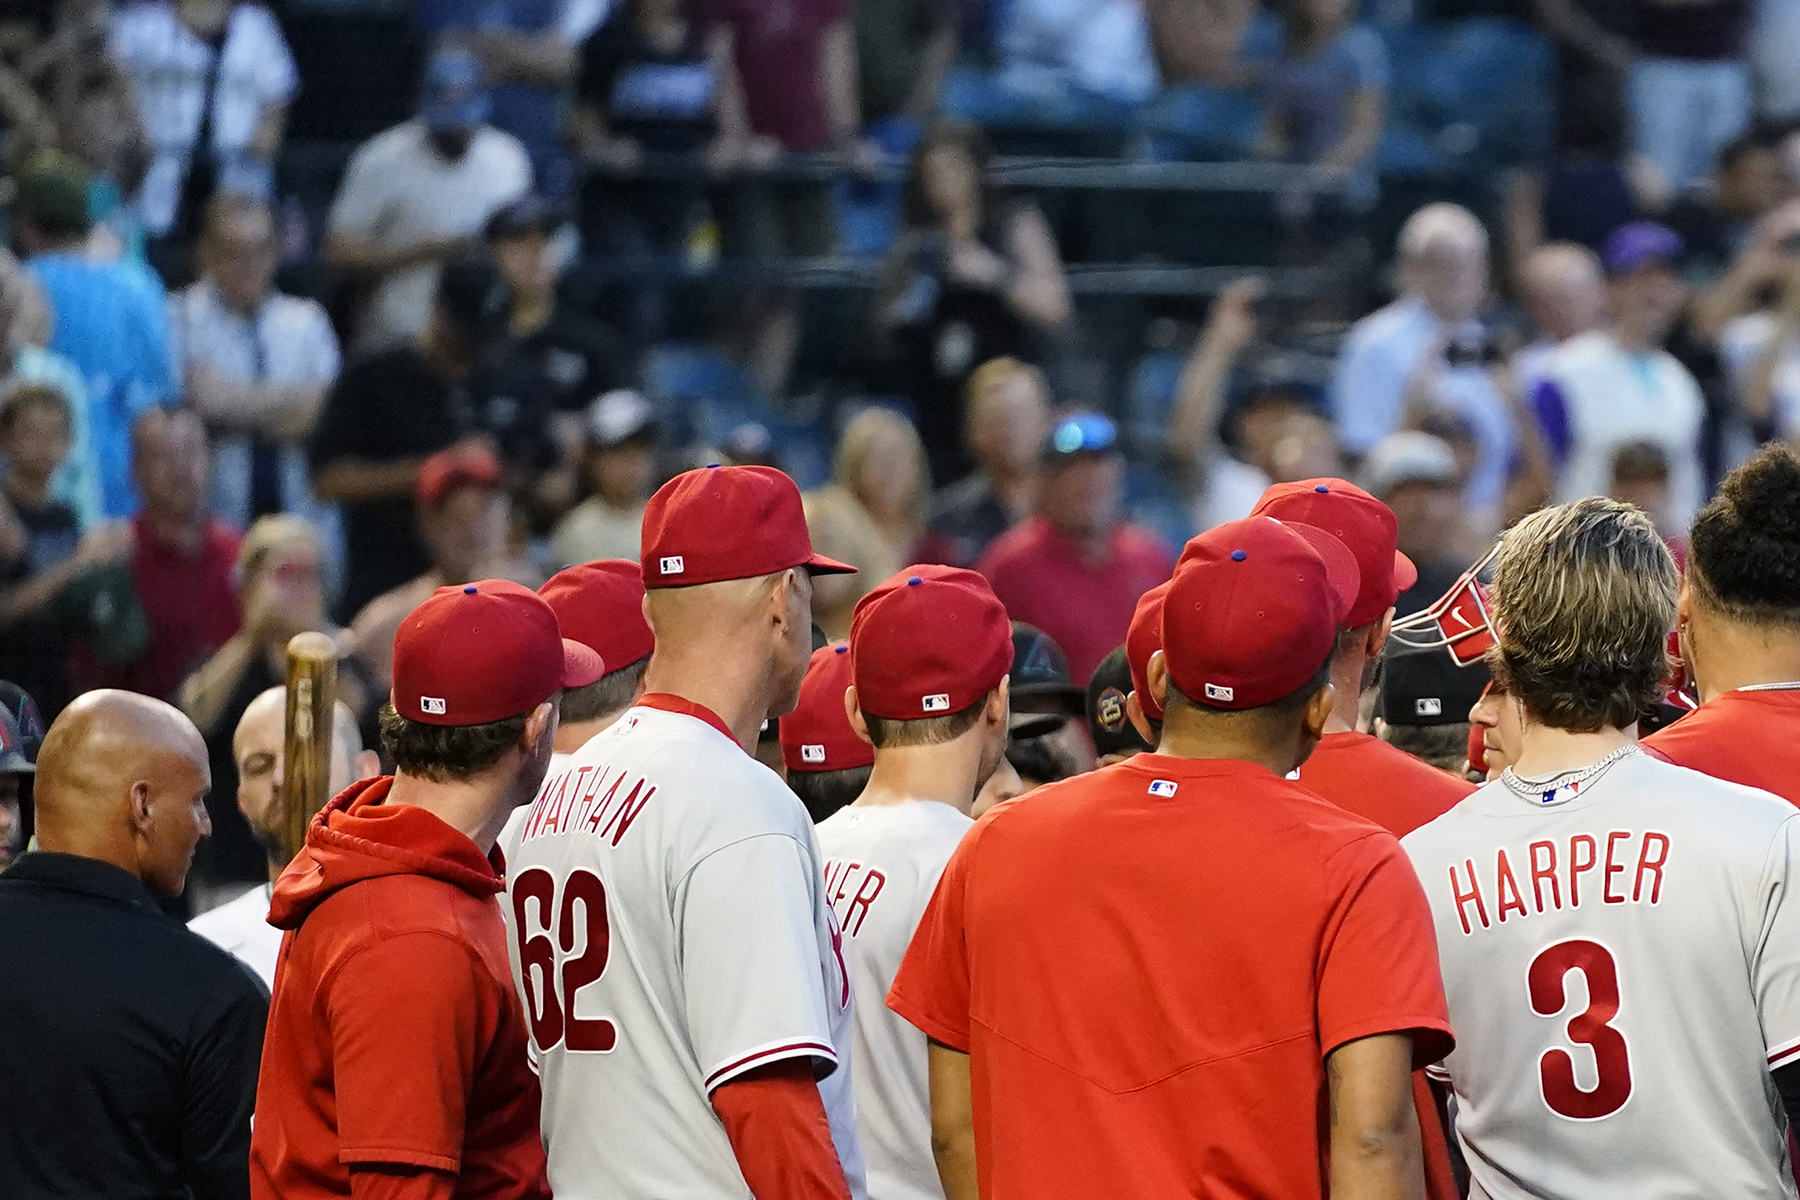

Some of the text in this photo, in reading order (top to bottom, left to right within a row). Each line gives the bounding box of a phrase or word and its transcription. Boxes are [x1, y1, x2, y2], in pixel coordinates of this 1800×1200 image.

[520, 764, 658, 849] WATHAN
[1448, 829, 1671, 937] HARPER
[511, 866, 618, 1055] 62
[1525, 936, 1635, 1122] 3
